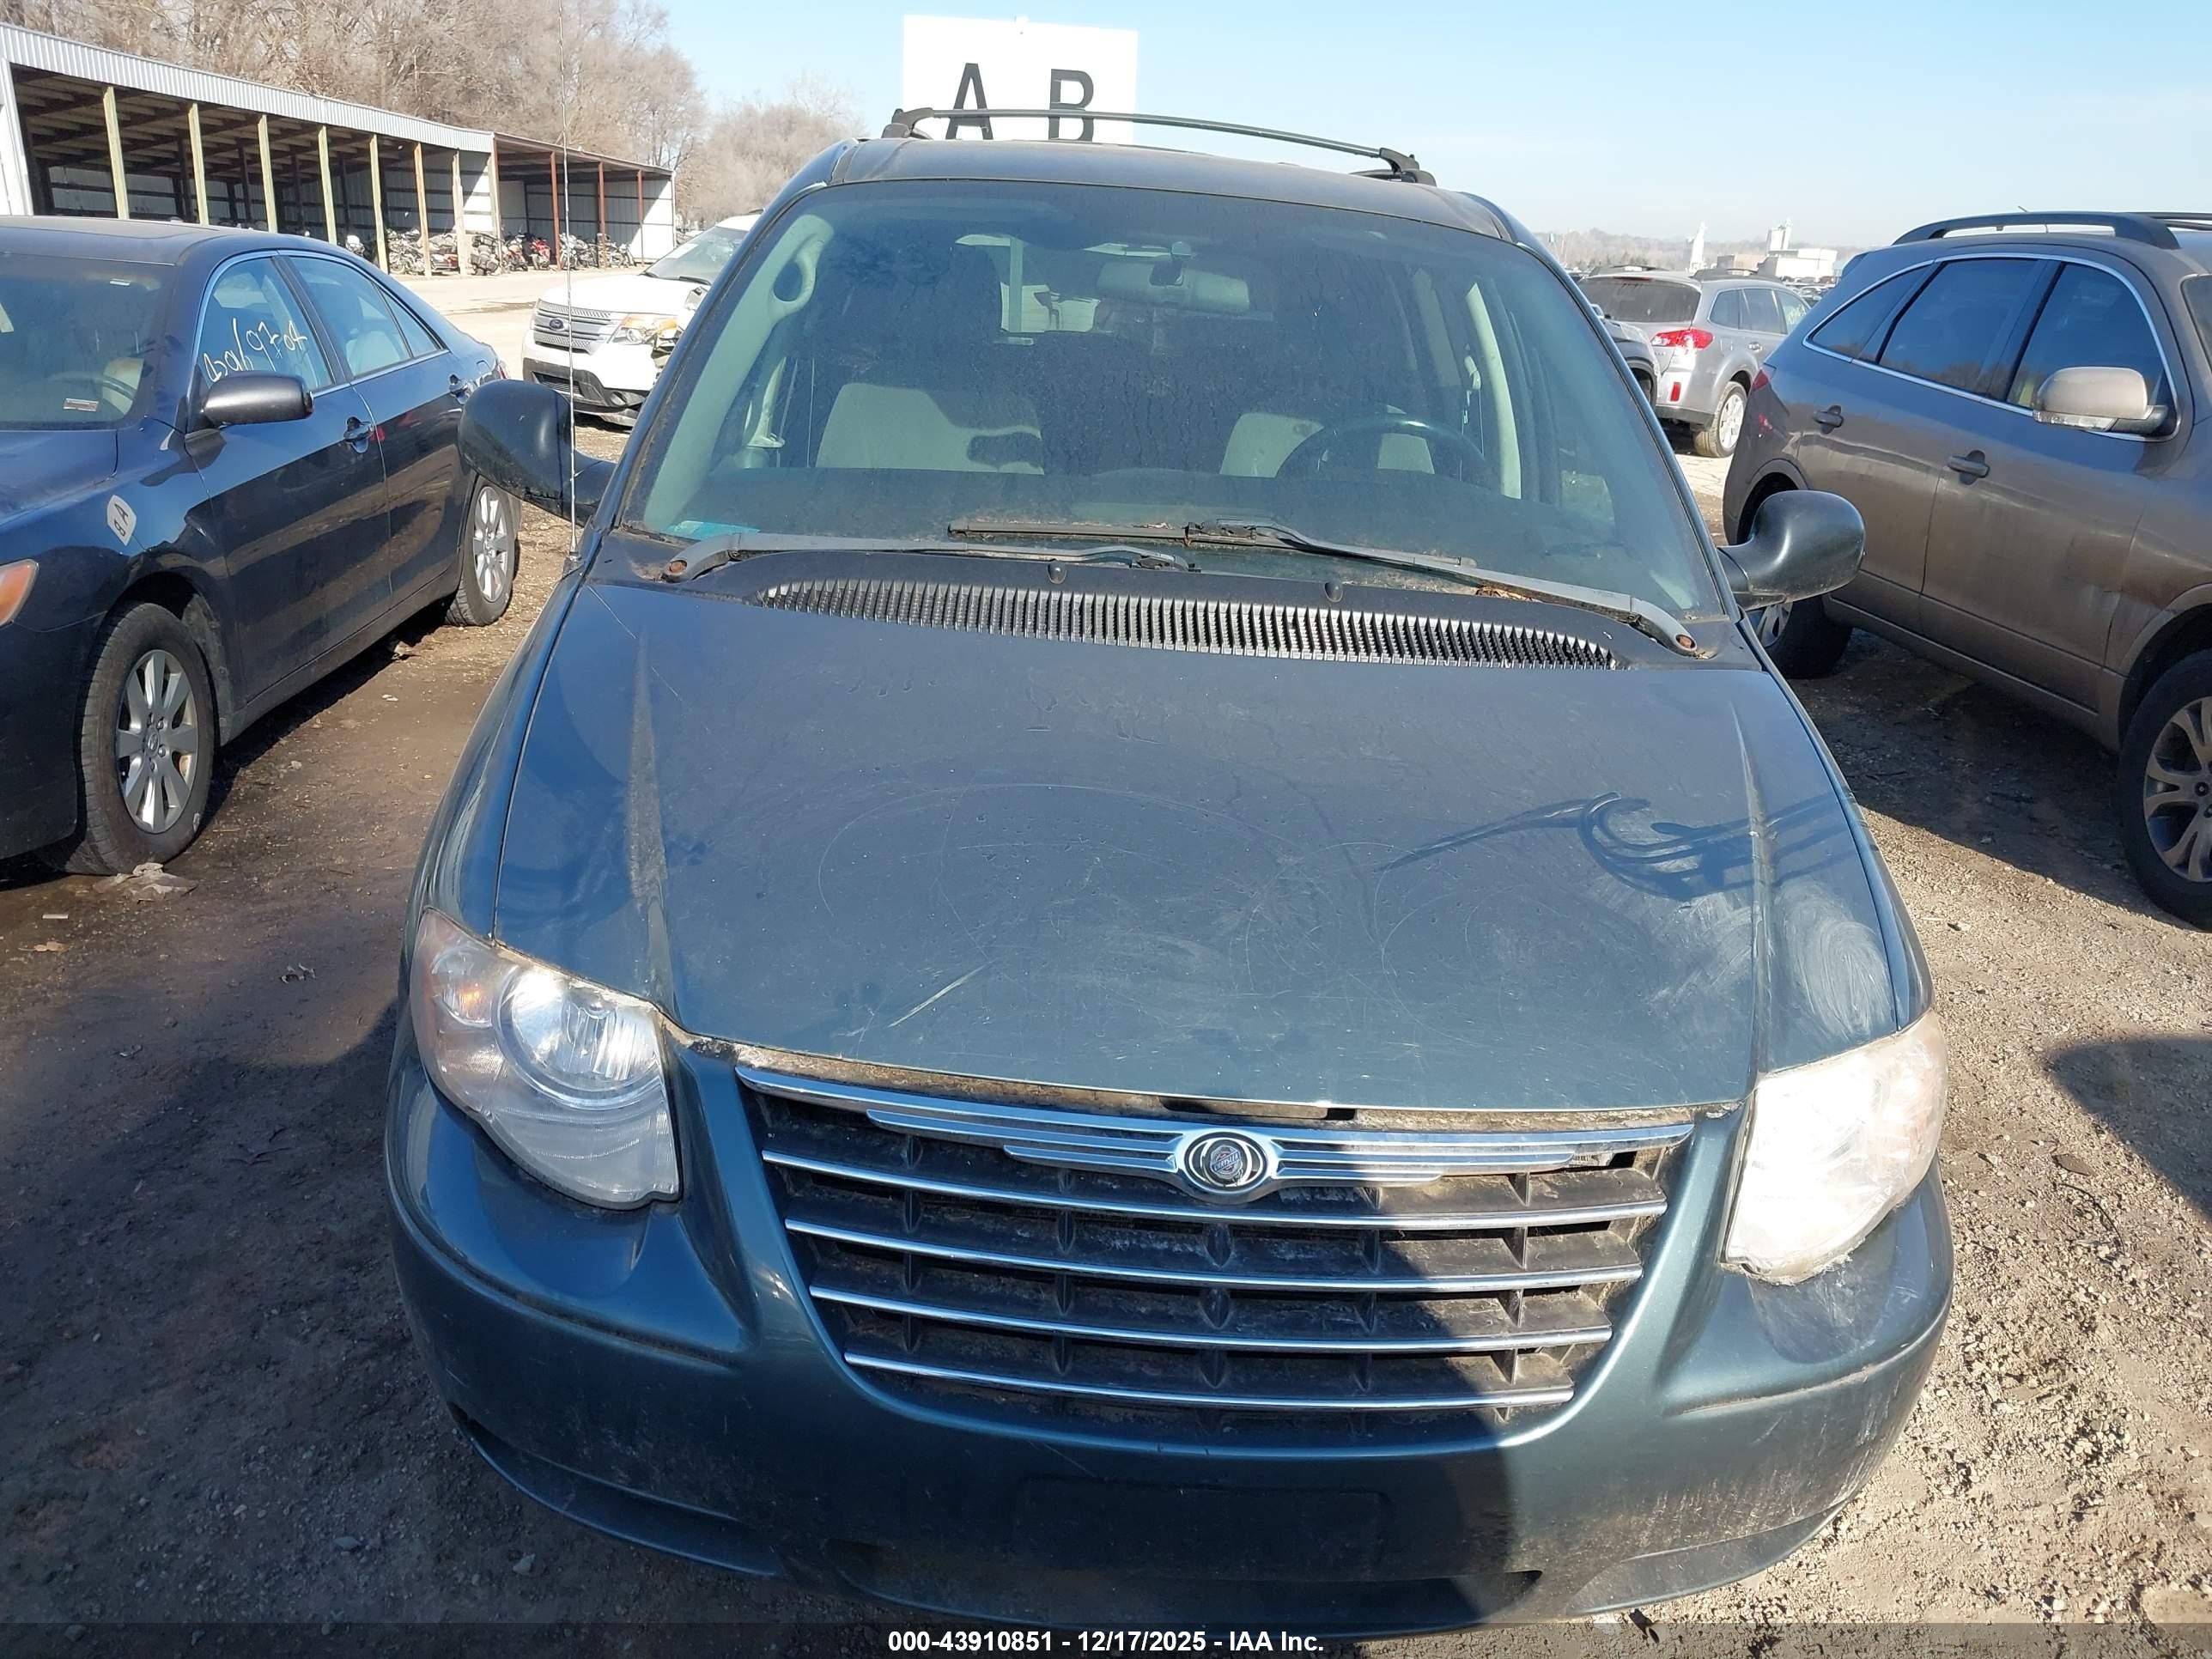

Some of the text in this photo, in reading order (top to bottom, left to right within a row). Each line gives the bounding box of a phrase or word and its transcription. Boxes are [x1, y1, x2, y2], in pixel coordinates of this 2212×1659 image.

[945, 63, 1094, 143] A B
[1212, 1152, 1241, 1172] CHRYSLER
